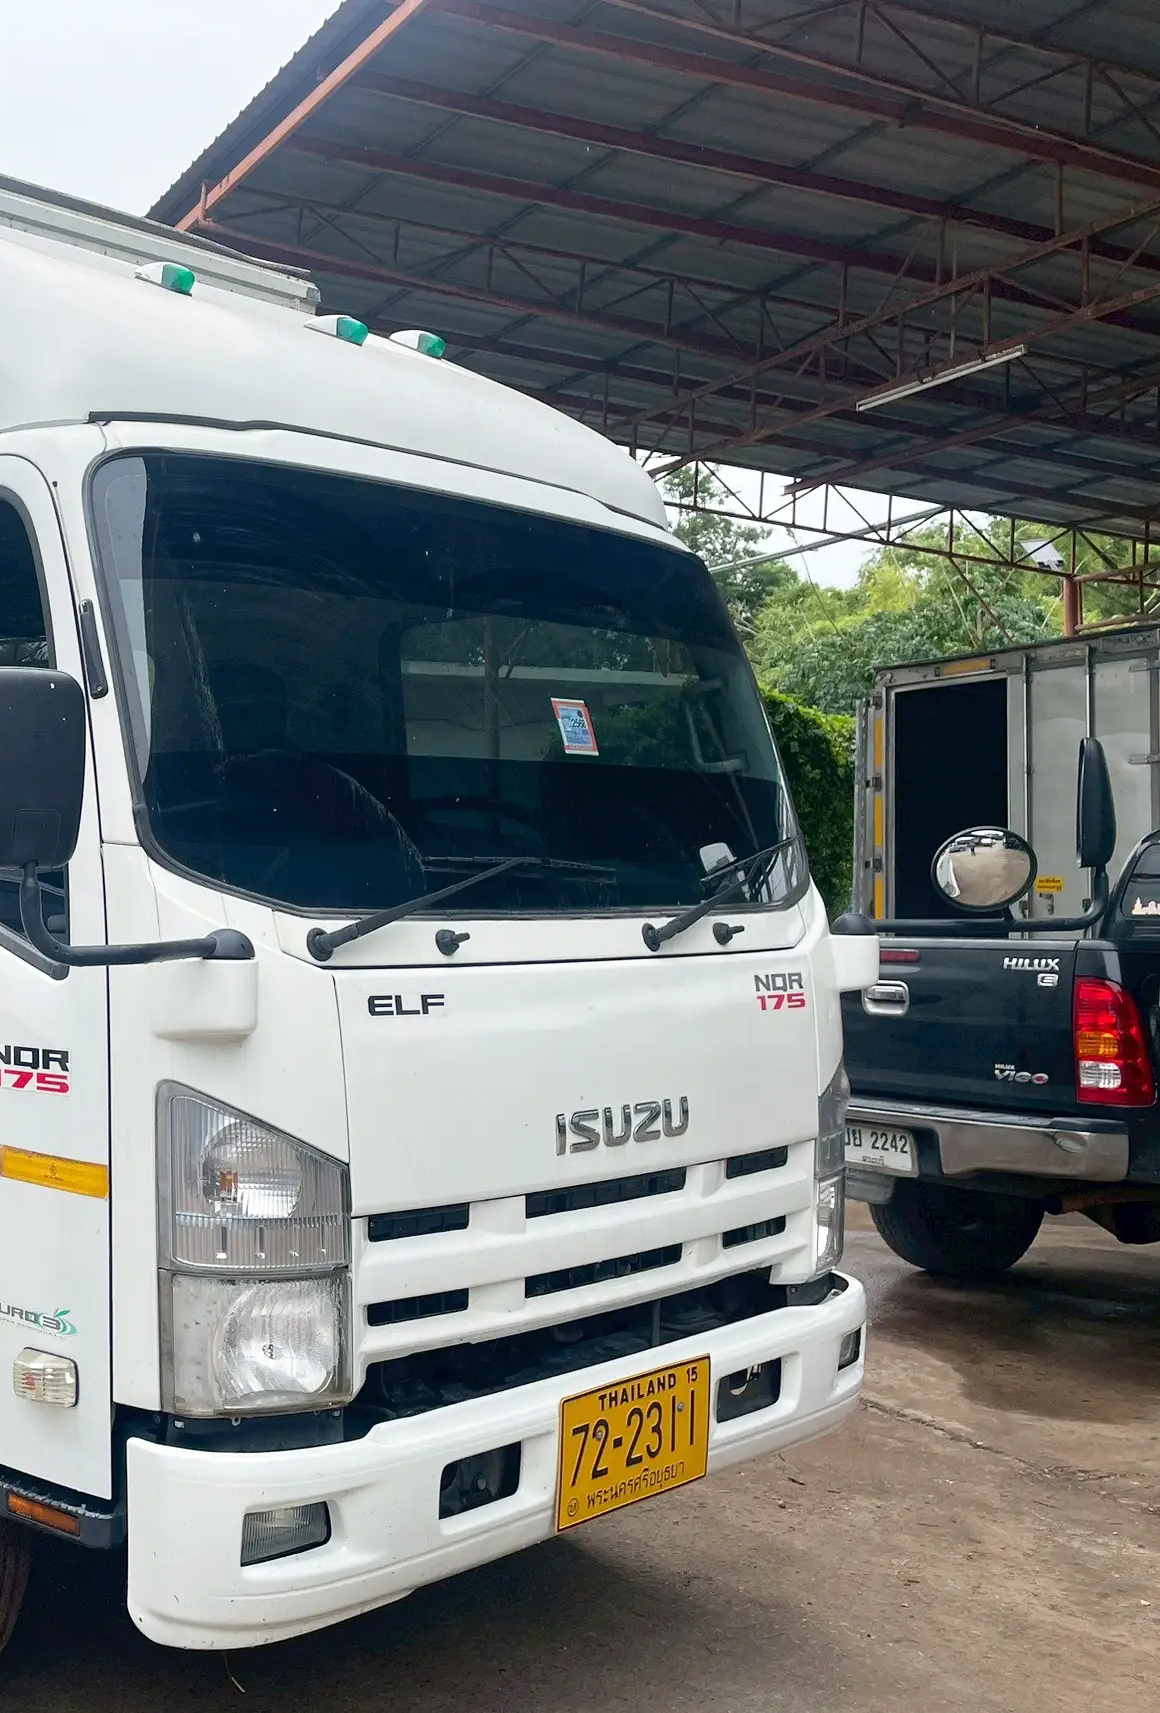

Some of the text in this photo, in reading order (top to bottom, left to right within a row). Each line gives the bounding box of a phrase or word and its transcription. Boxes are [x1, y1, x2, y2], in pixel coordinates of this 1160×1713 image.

[1003, 957, 1060, 971] HILUX
[754, 972, 804, 992] NQR
[367, 994, 445, 1016] ELF
[757, 992, 806, 1011] 175
[555, 1095, 690, 1156] ISUZU
[870, 1131, 909, 1154] 2242
[598, 1366, 698, 1412] THAILAND 15
[570, 1389, 696, 1487] 72-2311
[586, 1461, 685, 1509] พระนครศรีอยุธยา
